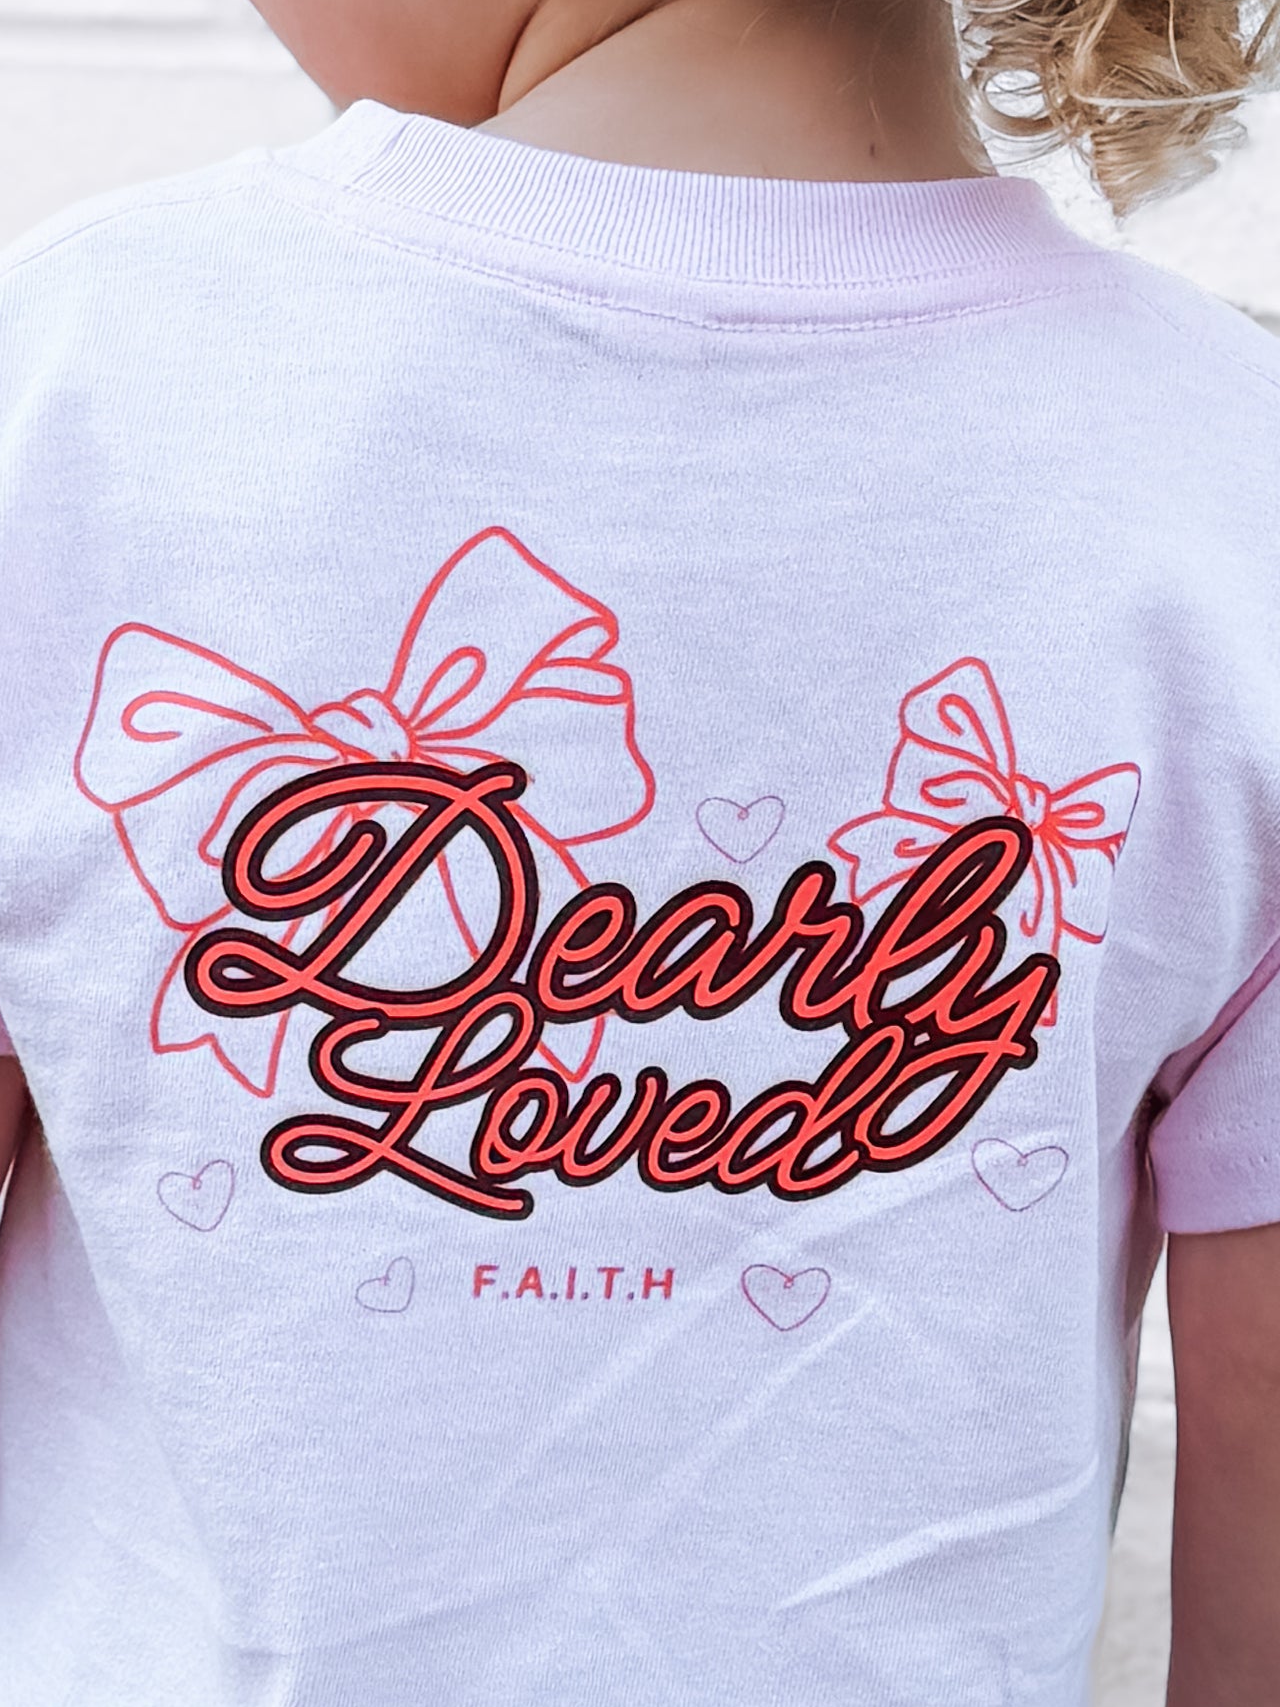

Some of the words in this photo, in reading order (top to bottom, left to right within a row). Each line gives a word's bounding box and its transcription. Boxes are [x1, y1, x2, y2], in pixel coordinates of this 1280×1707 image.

[185, 761, 1061, 1174] Dearly
[260, 984, 912, 1221] Loved
[472, 1263, 676, 1300] F.A.I.T.H
